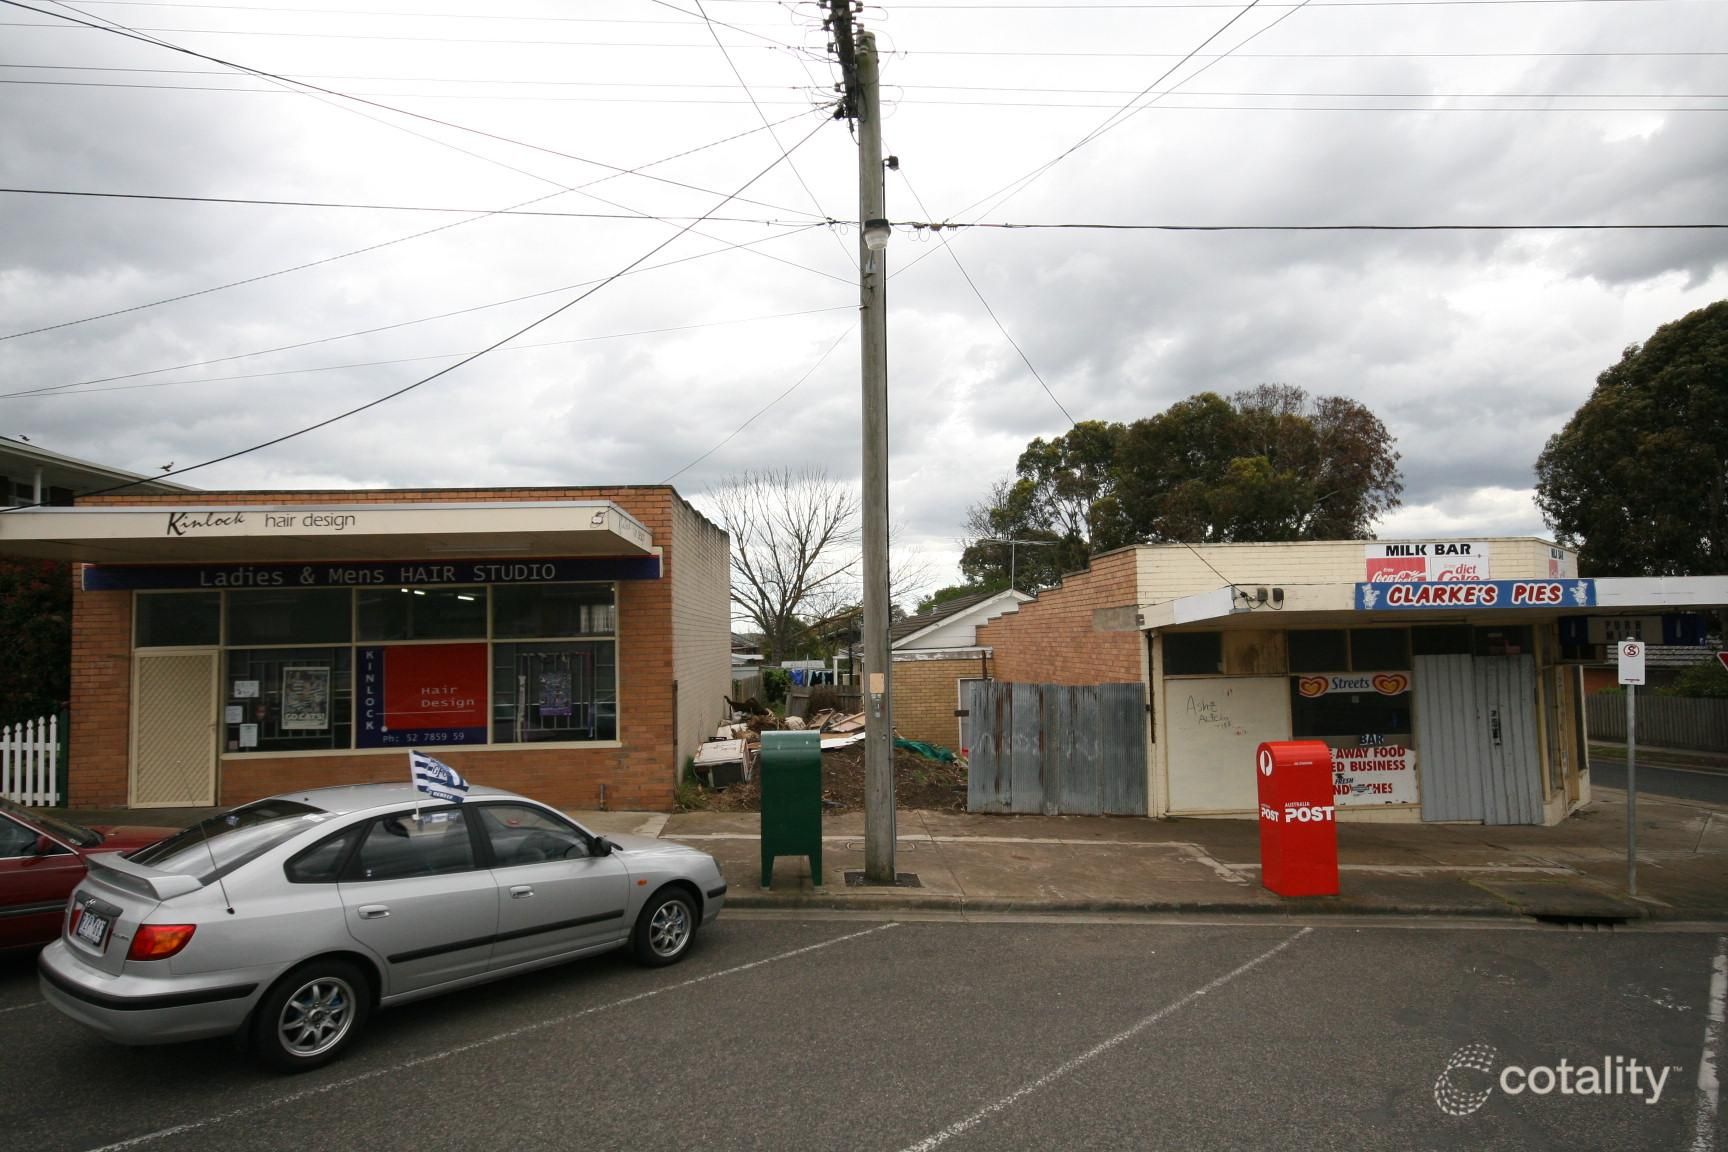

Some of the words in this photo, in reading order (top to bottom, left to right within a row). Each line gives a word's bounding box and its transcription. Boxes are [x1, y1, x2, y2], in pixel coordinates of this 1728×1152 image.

[166, 511, 247, 536] Kinlock
[265, 513, 296, 528] hair
[302, 513, 356, 531] design
[1385, 544, 1427, 557] MILK
[1434, 543, 1472, 556] BAR
[199, 566, 284, 587] Ladies
[299, 566, 316, 585] &
[328, 567, 385, 585] Mens
[400, 565, 456, 582] HAIR
[473, 563, 556, 581] STUDIO
[1456, 563, 1477, 574] diet
[1388, 584, 1498, 605] CLARKE'S
[1512, 583, 1563, 603] PIES
[364, 650, 374, 731] KINLOCK
[421, 685, 459, 695] Hair
[1331, 676, 1370, 691] Streets
[421, 697, 475, 709] Design
[383, 734, 399, 743] Ph:
[1360, 734, 1384, 745] BAR
[1335, 747, 1369, 759] AWAY
[1373, 746, 1406, 758] FOOD
[1350, 760, 1406, 772] BUSINESS
[1260, 807, 1280, 823] POST
[1285, 806, 1335, 823] POST
